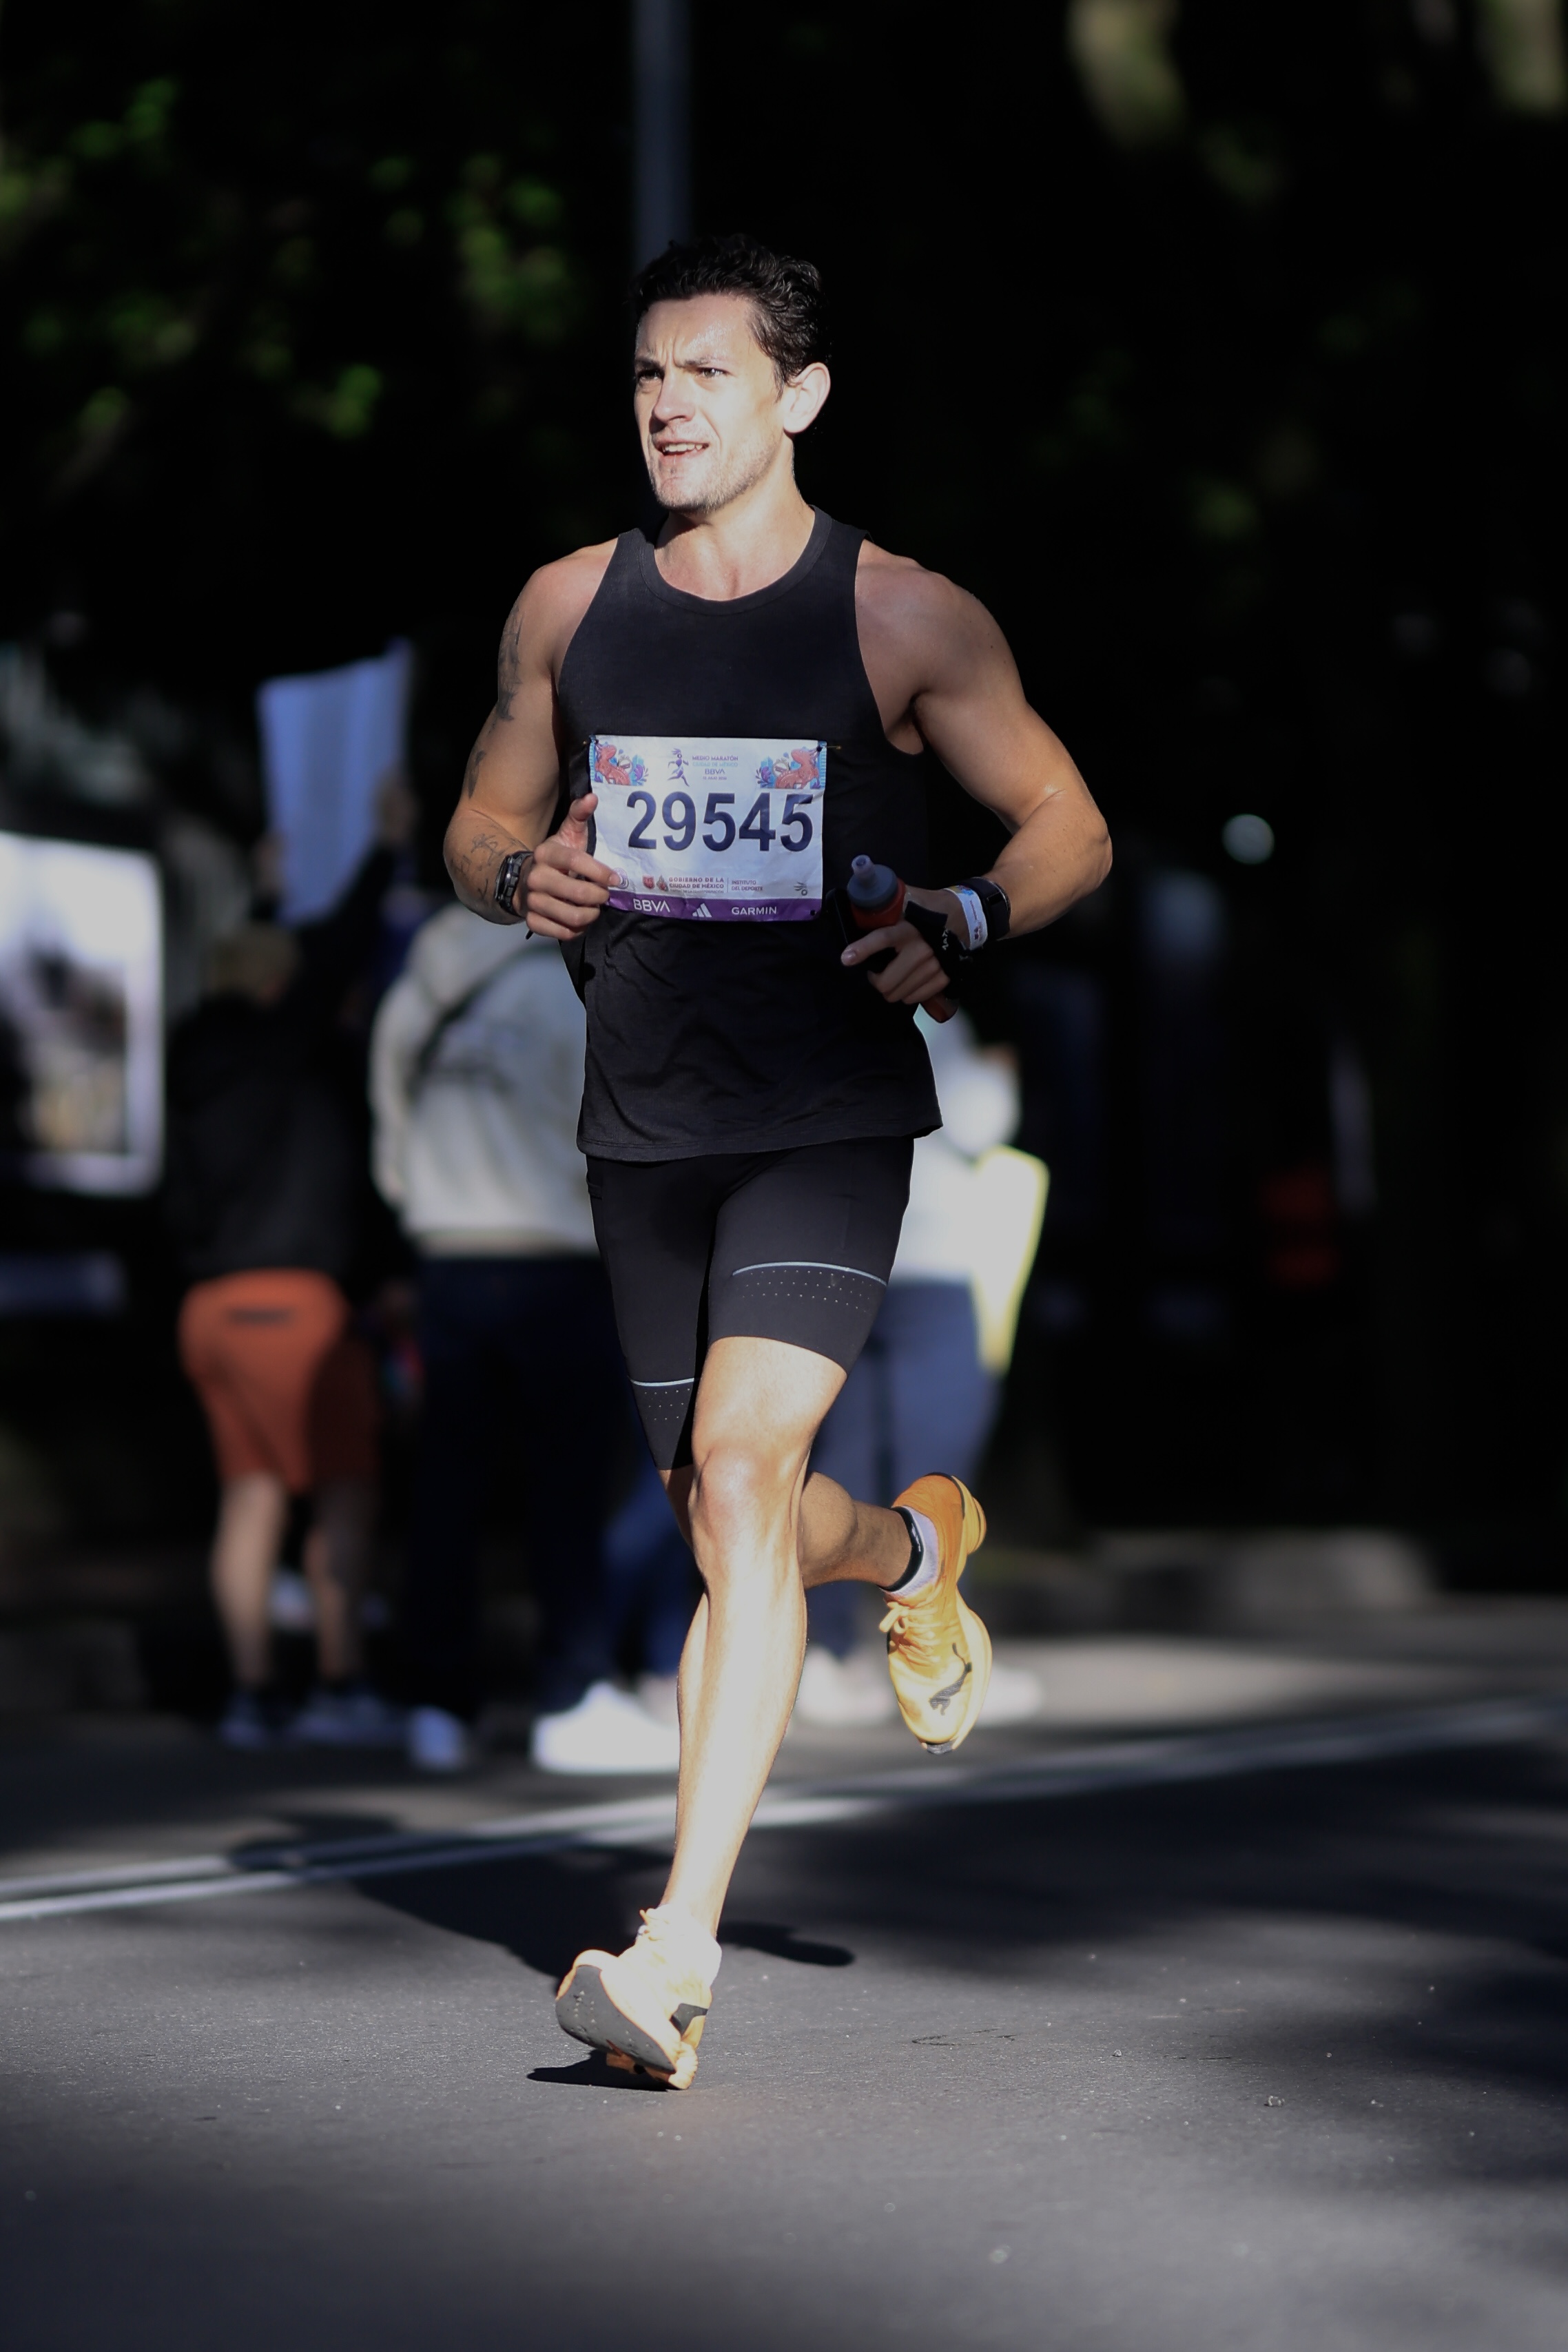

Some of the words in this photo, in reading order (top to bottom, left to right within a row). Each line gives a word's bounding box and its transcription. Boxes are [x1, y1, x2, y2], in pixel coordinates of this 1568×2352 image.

[626, 790, 813, 852] 29545
[633, 898, 670, 913] BBVA
[732, 906, 778, 916] GARMIN
